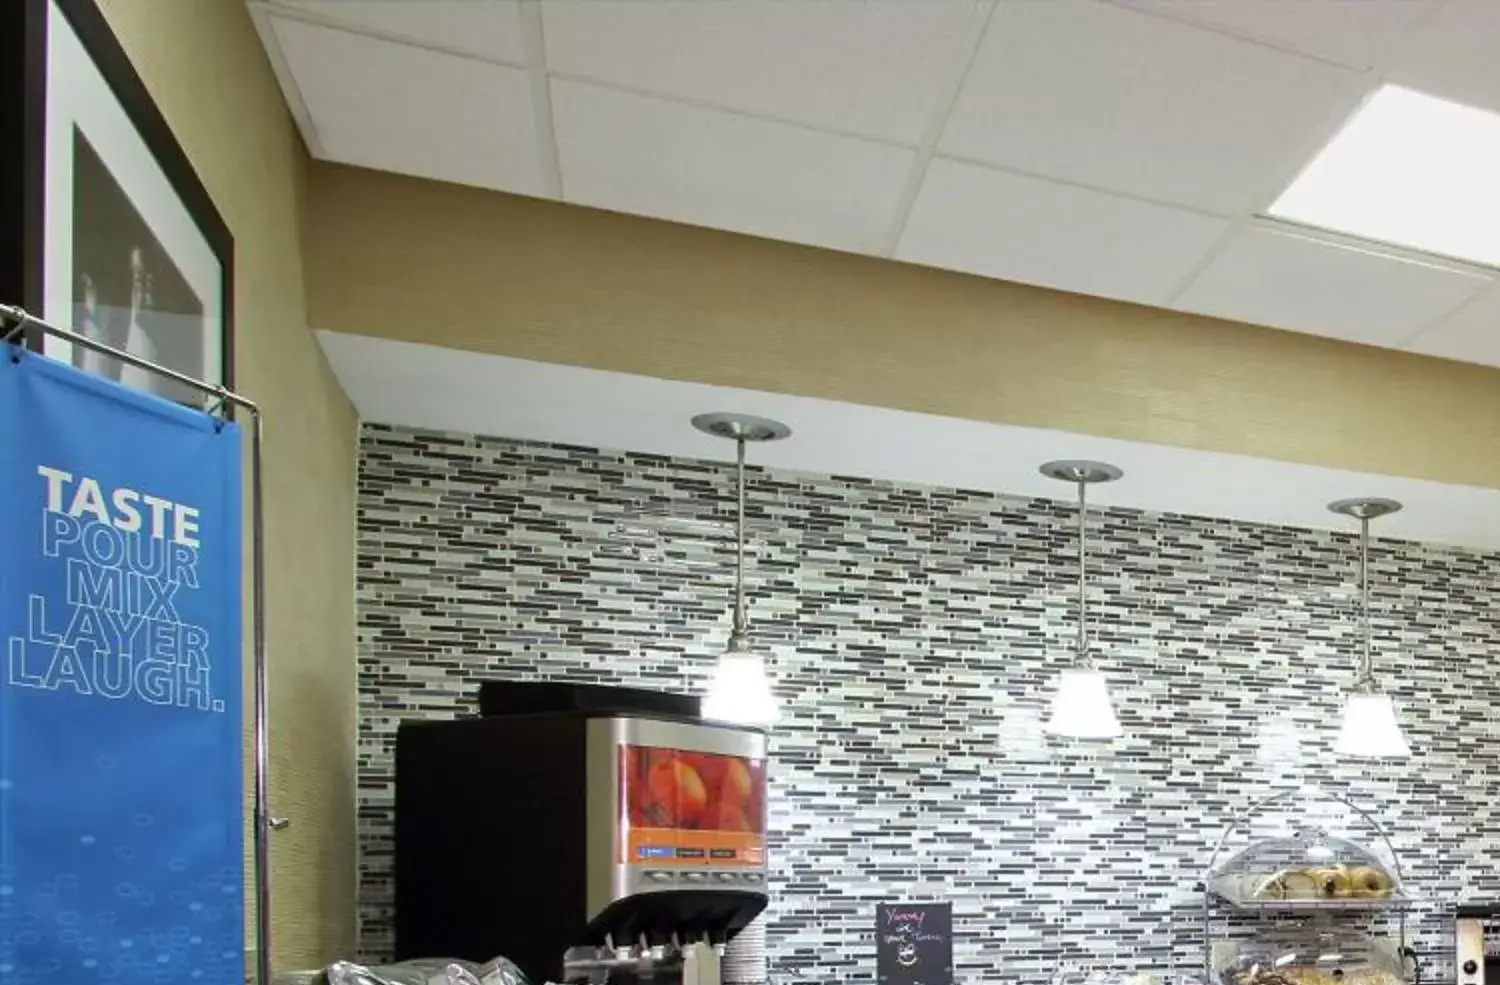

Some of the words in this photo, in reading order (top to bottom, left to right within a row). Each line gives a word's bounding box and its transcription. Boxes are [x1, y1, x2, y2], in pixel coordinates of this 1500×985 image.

[38, 465, 200, 548] TASTE
[43, 508, 200, 589] POUR
[67, 558, 181, 626] MIX
[29, 594, 212, 672] LAYER
[9, 636, 225, 713] LAUGH.
